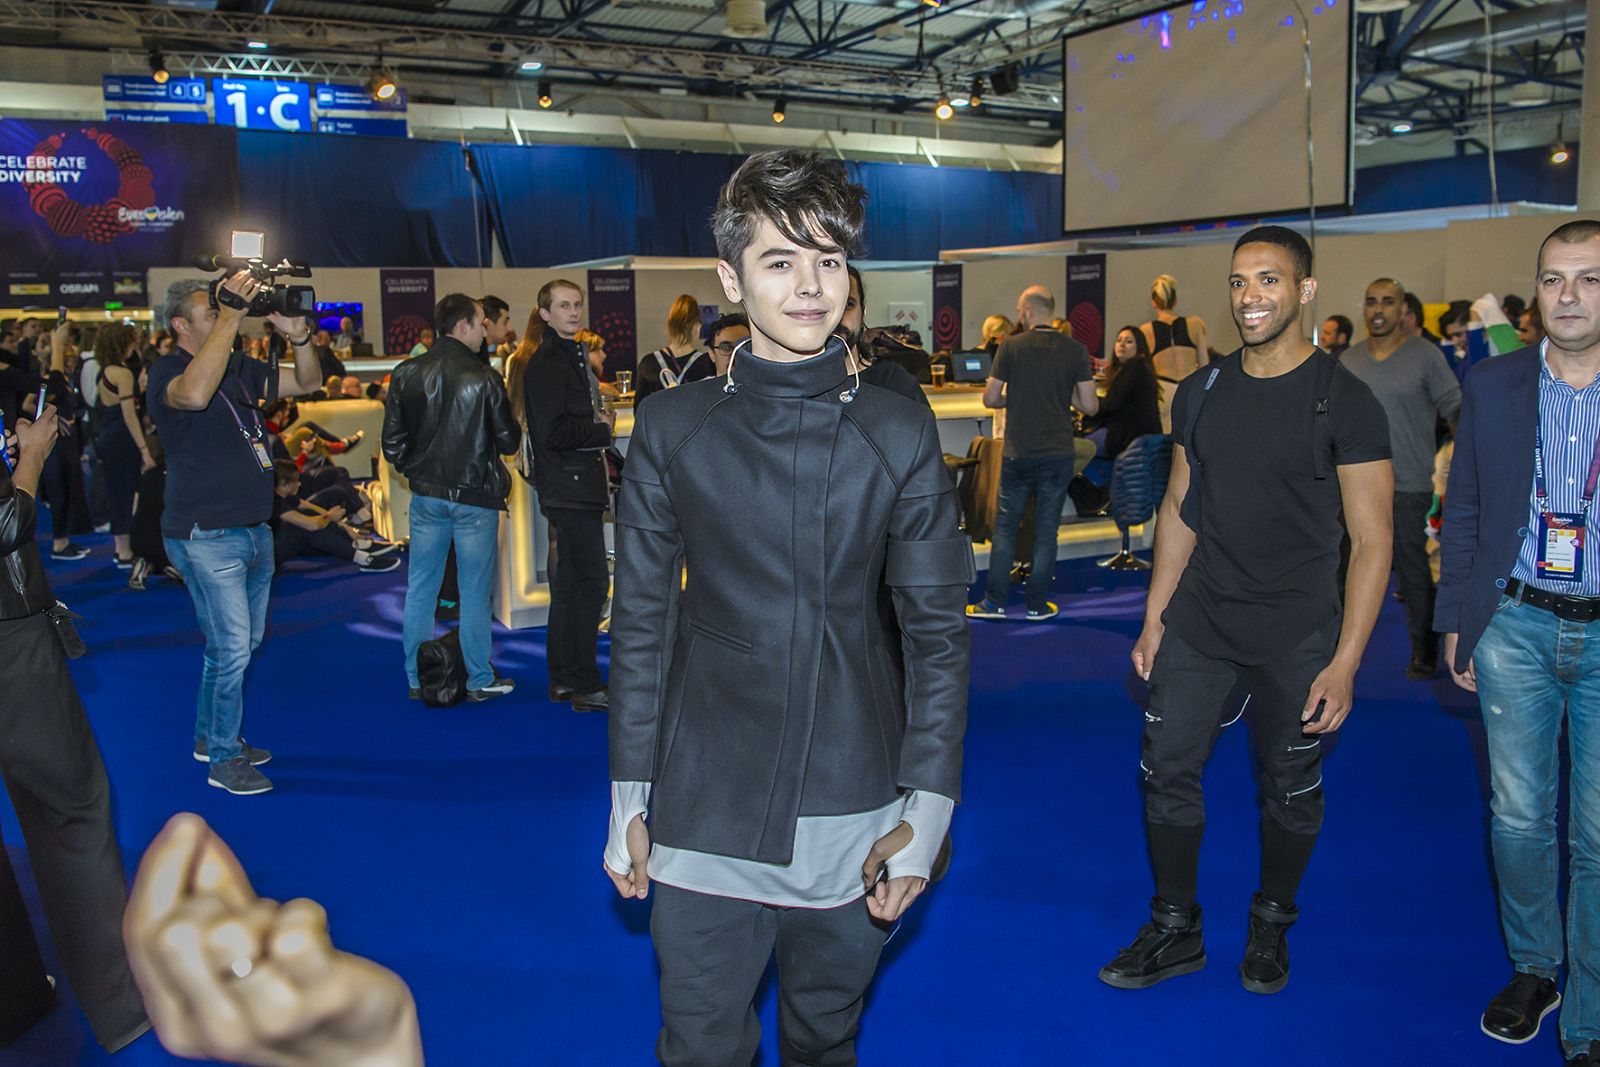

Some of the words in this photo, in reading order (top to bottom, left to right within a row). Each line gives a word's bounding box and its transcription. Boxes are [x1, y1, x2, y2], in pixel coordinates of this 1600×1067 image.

[174, 86, 183, 96] 4
[226, 91, 248, 129] 1
[269, 92, 301, 131] C
[0, 155, 87, 170] CELEBRATE
[0, 170, 81, 184] DIVERSITY
